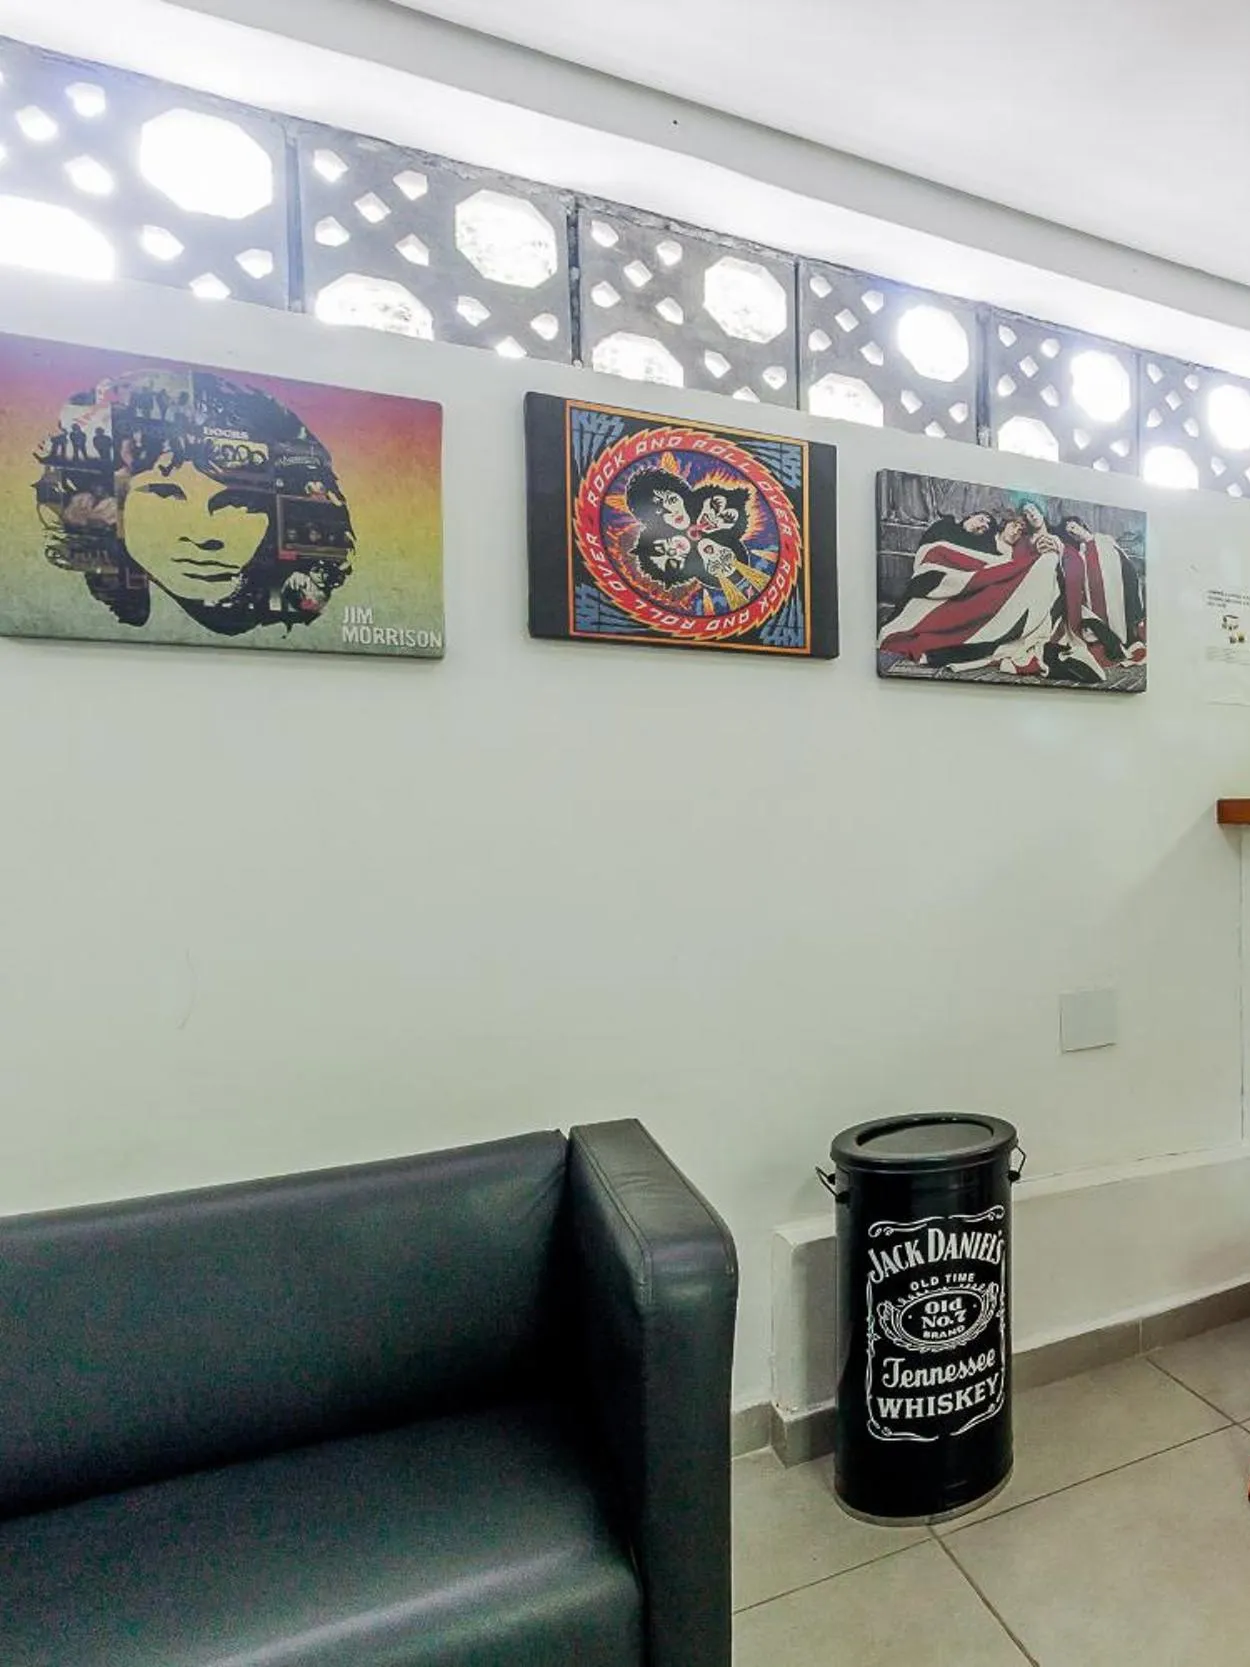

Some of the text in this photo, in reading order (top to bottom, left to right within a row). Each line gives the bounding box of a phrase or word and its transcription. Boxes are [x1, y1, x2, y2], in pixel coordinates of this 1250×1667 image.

[587, 454, 626, 508] ROCK
[691, 439, 752, 473] ROLL
[756, 481, 793, 537] OVER
[342, 605, 374, 624] JIM
[342, 625, 443, 648] MORRISON
[867, 1239, 925, 1284] JACK
[910, 1272, 976, 1292] OLD TIME
[924, 1297, 962, 1315] Old
[922, 1324, 965, 1340] BRAND
[882, 1348, 996, 1389] Tennessee
[876, 1373, 1000, 1419] WHISKEY
